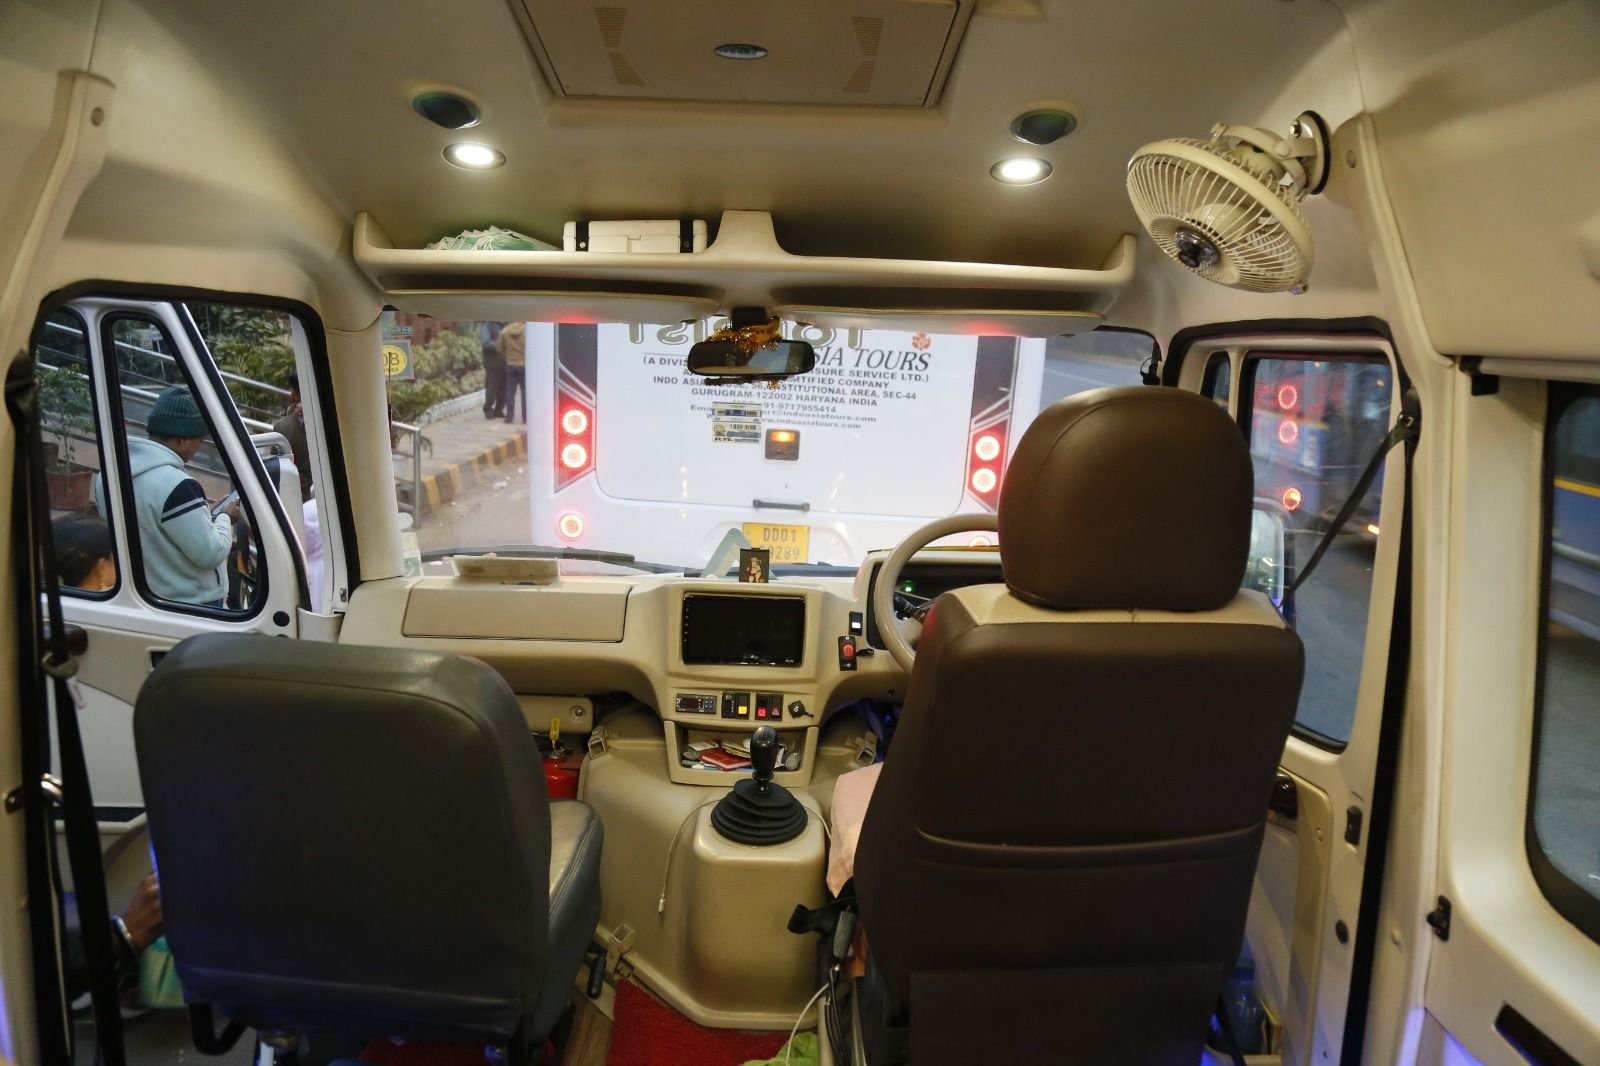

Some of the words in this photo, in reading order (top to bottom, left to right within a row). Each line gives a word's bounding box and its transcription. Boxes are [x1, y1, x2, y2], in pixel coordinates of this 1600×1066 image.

[854, 348, 931, 372] TOURS
[849, 369, 897, 381] SERVICE
[901, 373, 929, 383] LTD.)
[653, 376, 678, 385] INDO
[851, 388, 879, 398] AREA,
[883, 390, 917, 400] SEC-44
[838, 378, 890, 389] COMPANY
[796, 394, 846, 405] HARYANA
[849, 397, 878, 407] INDIA
